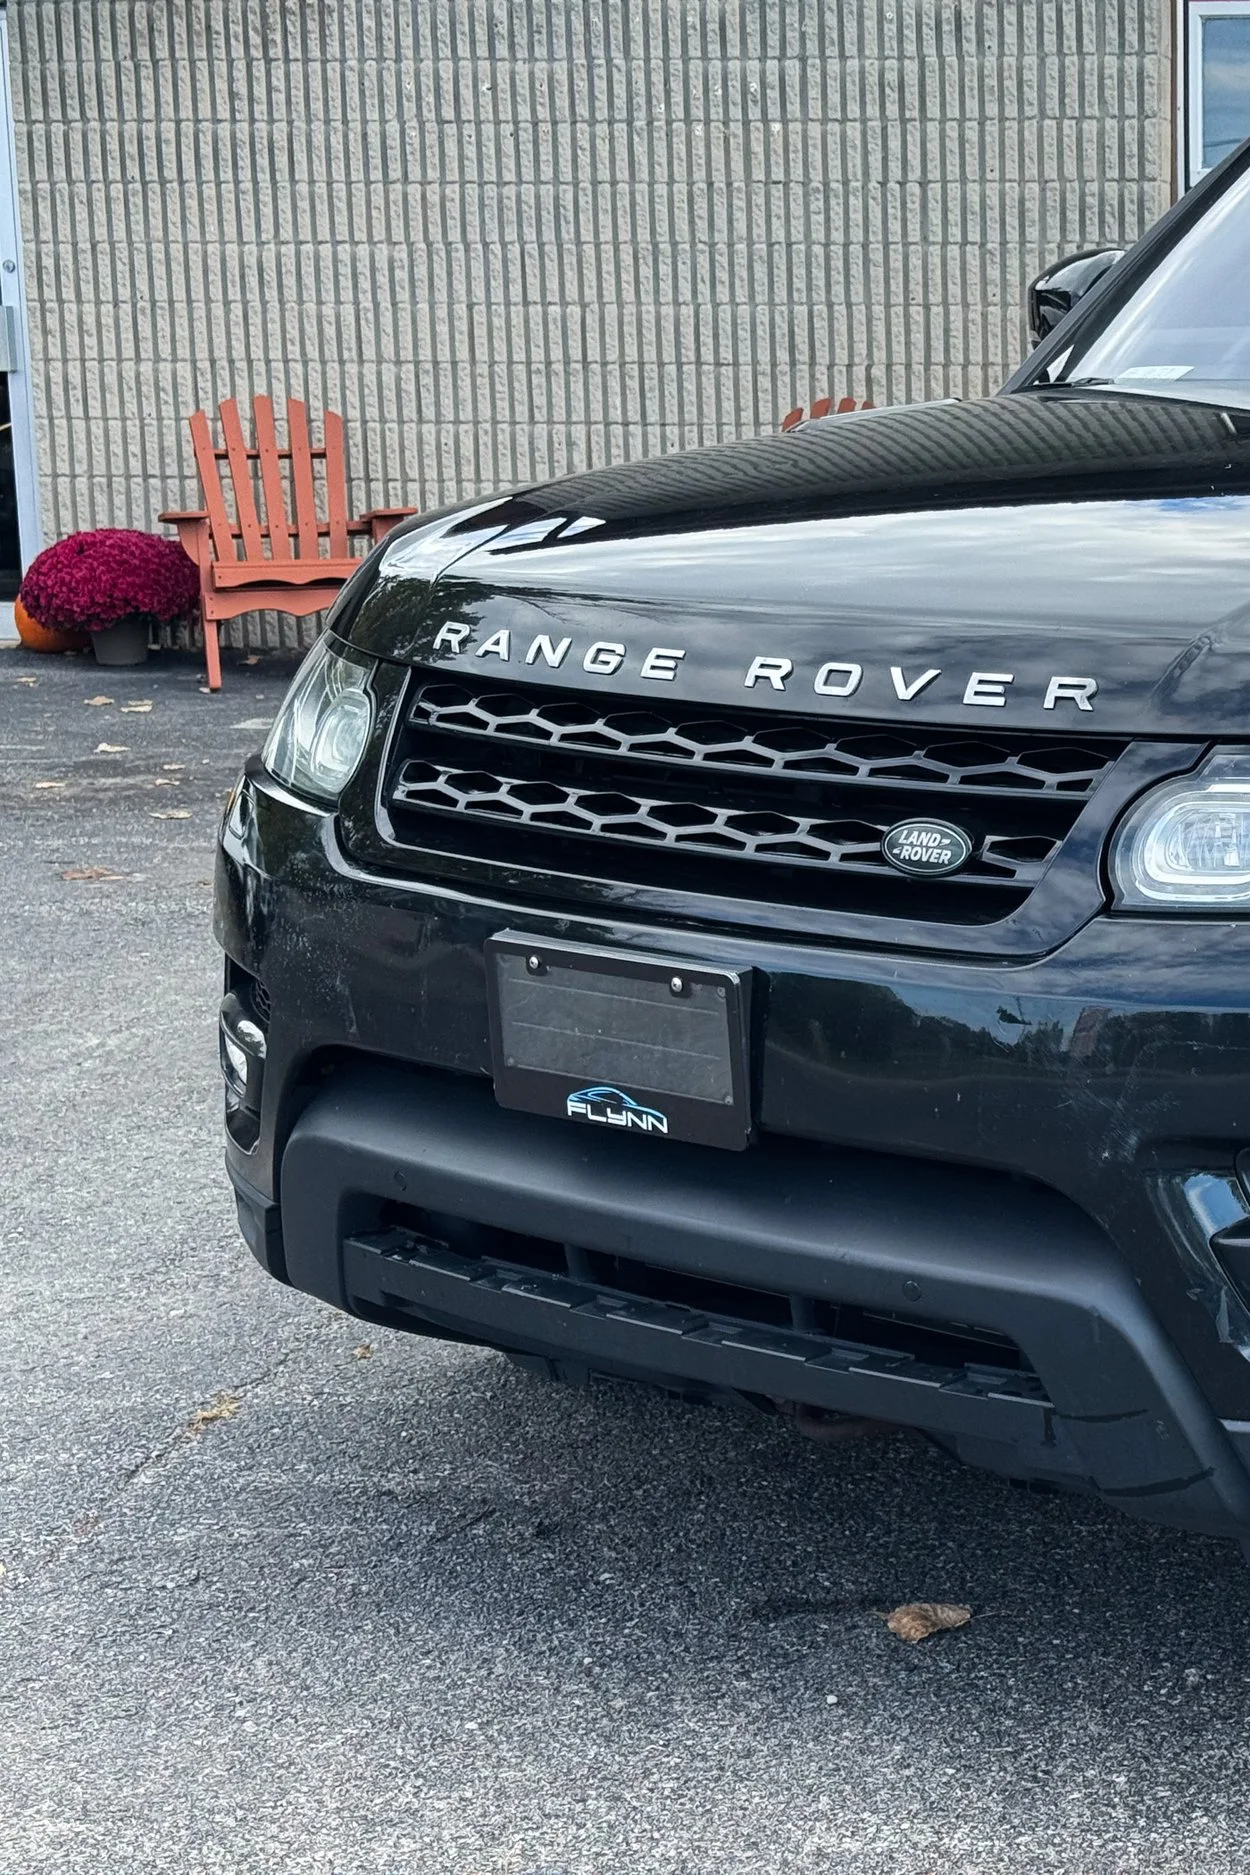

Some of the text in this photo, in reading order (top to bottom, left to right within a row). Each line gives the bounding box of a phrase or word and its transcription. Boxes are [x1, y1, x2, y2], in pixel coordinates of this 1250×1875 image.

[434, 621, 1098, 710] RANGE ROVER
[898, 830, 942, 847] LAND
[899, 846, 951, 864] ROVER
[567, 1101, 669, 1133] FLYNN
